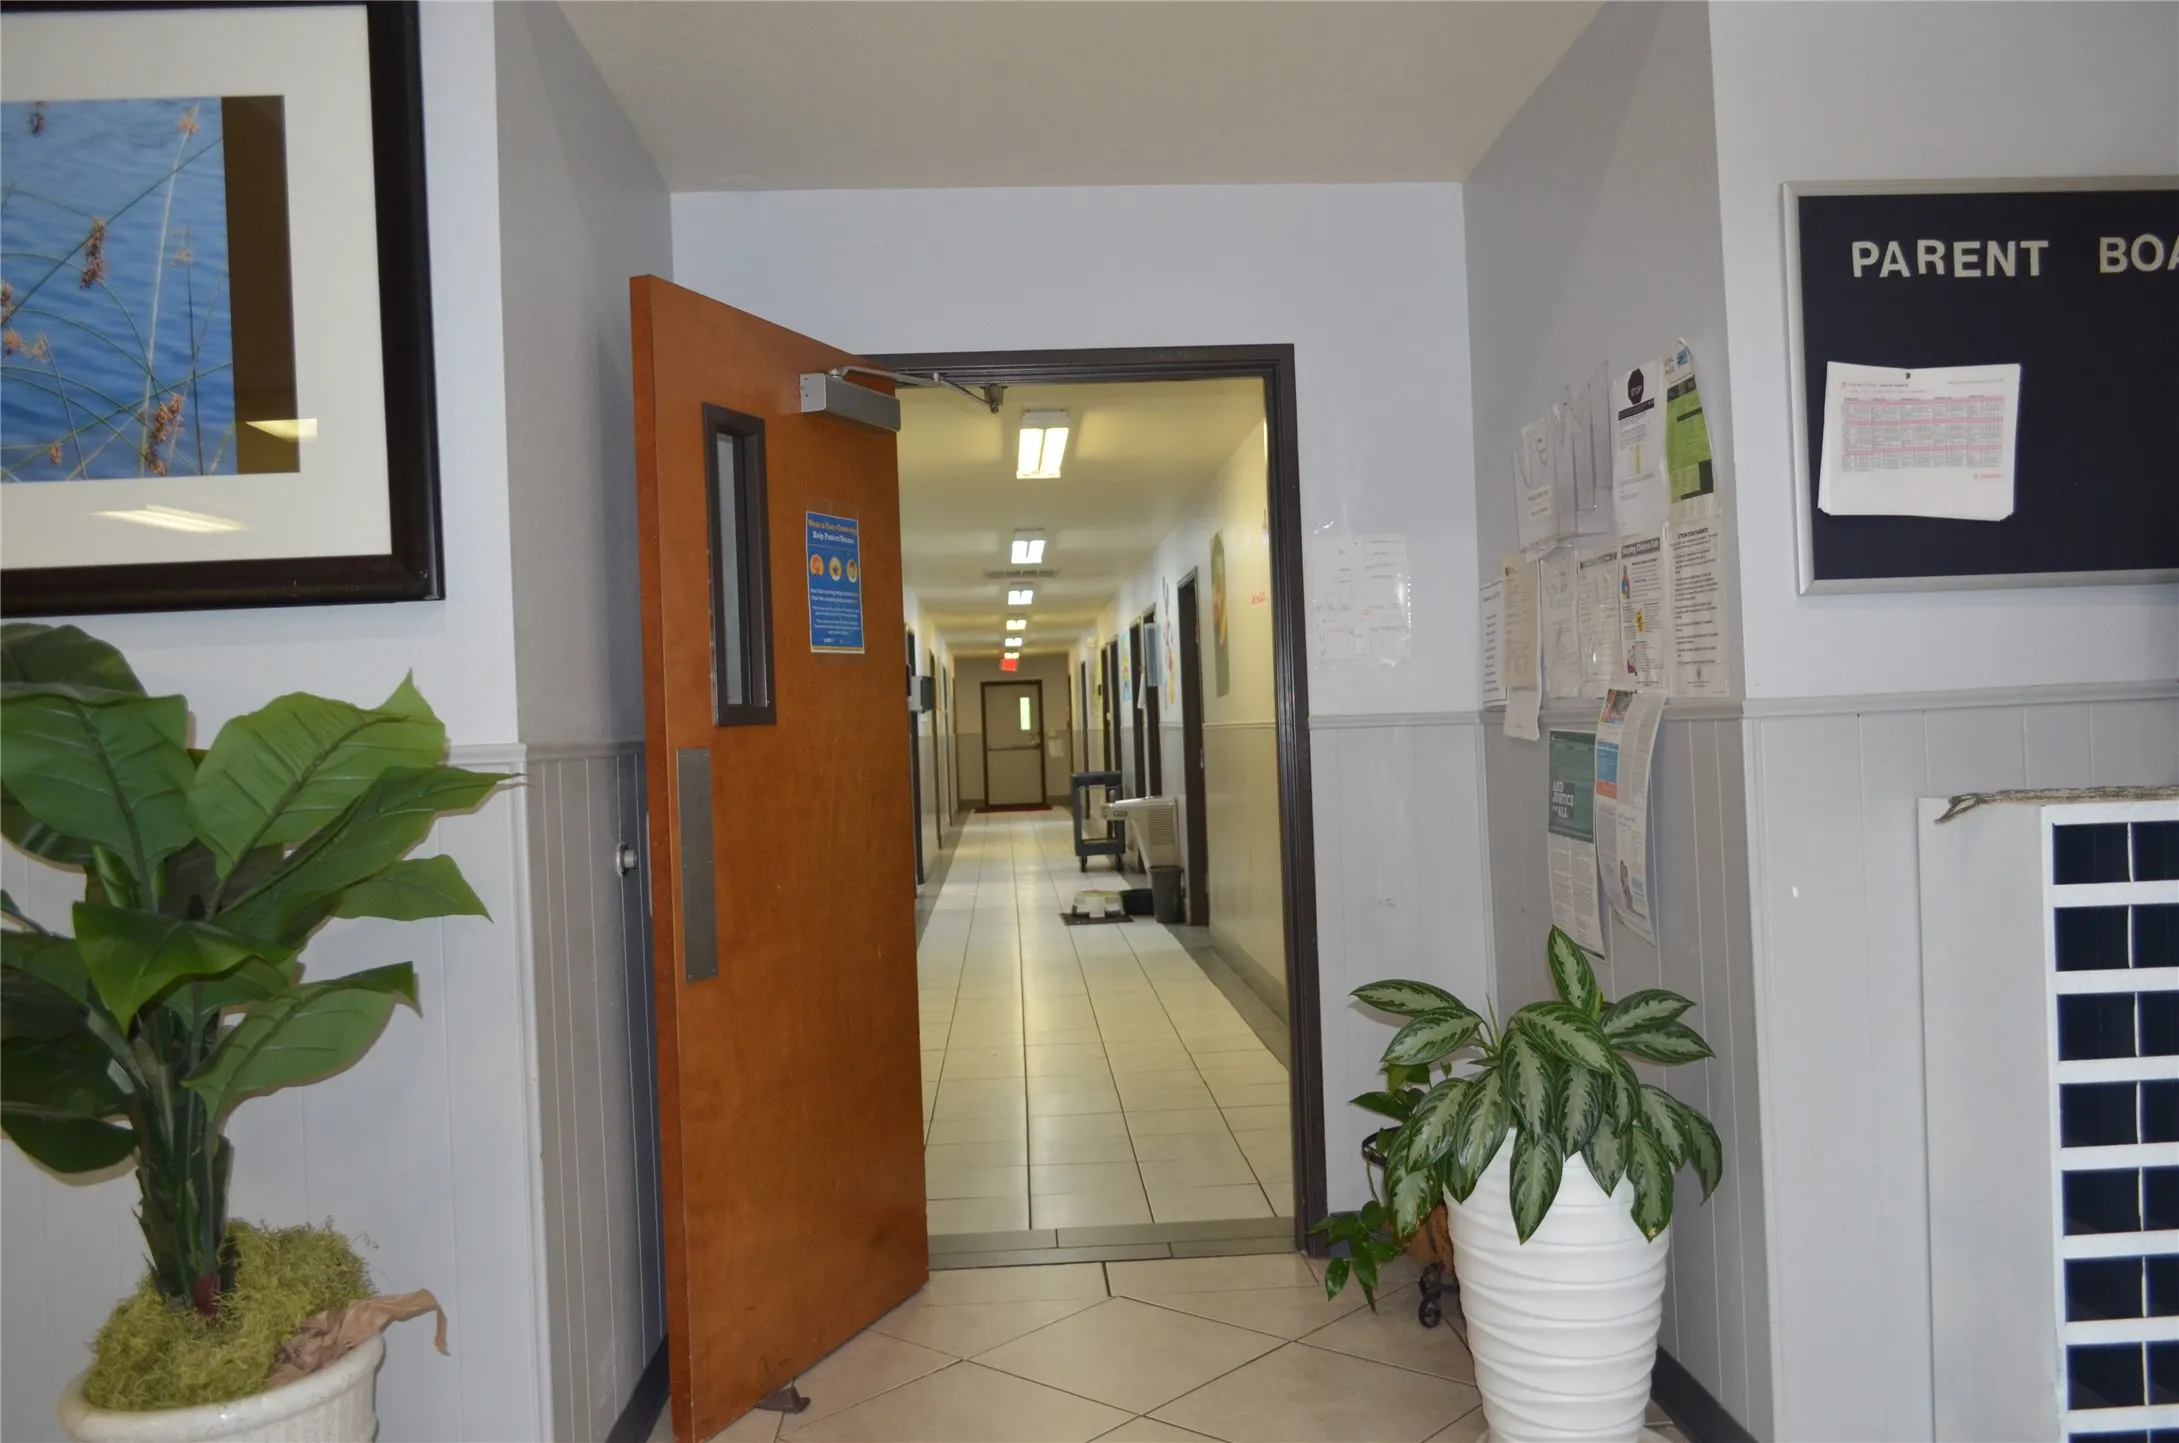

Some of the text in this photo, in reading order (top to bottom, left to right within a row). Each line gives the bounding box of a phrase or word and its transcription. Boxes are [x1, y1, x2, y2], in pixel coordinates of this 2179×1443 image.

[1852, 239, 2049, 279] PARENT
[1552, 781, 1564, 793] AND
[1552, 792, 1574, 806] JUSTICE
[1558, 806, 1568, 818] ALL
